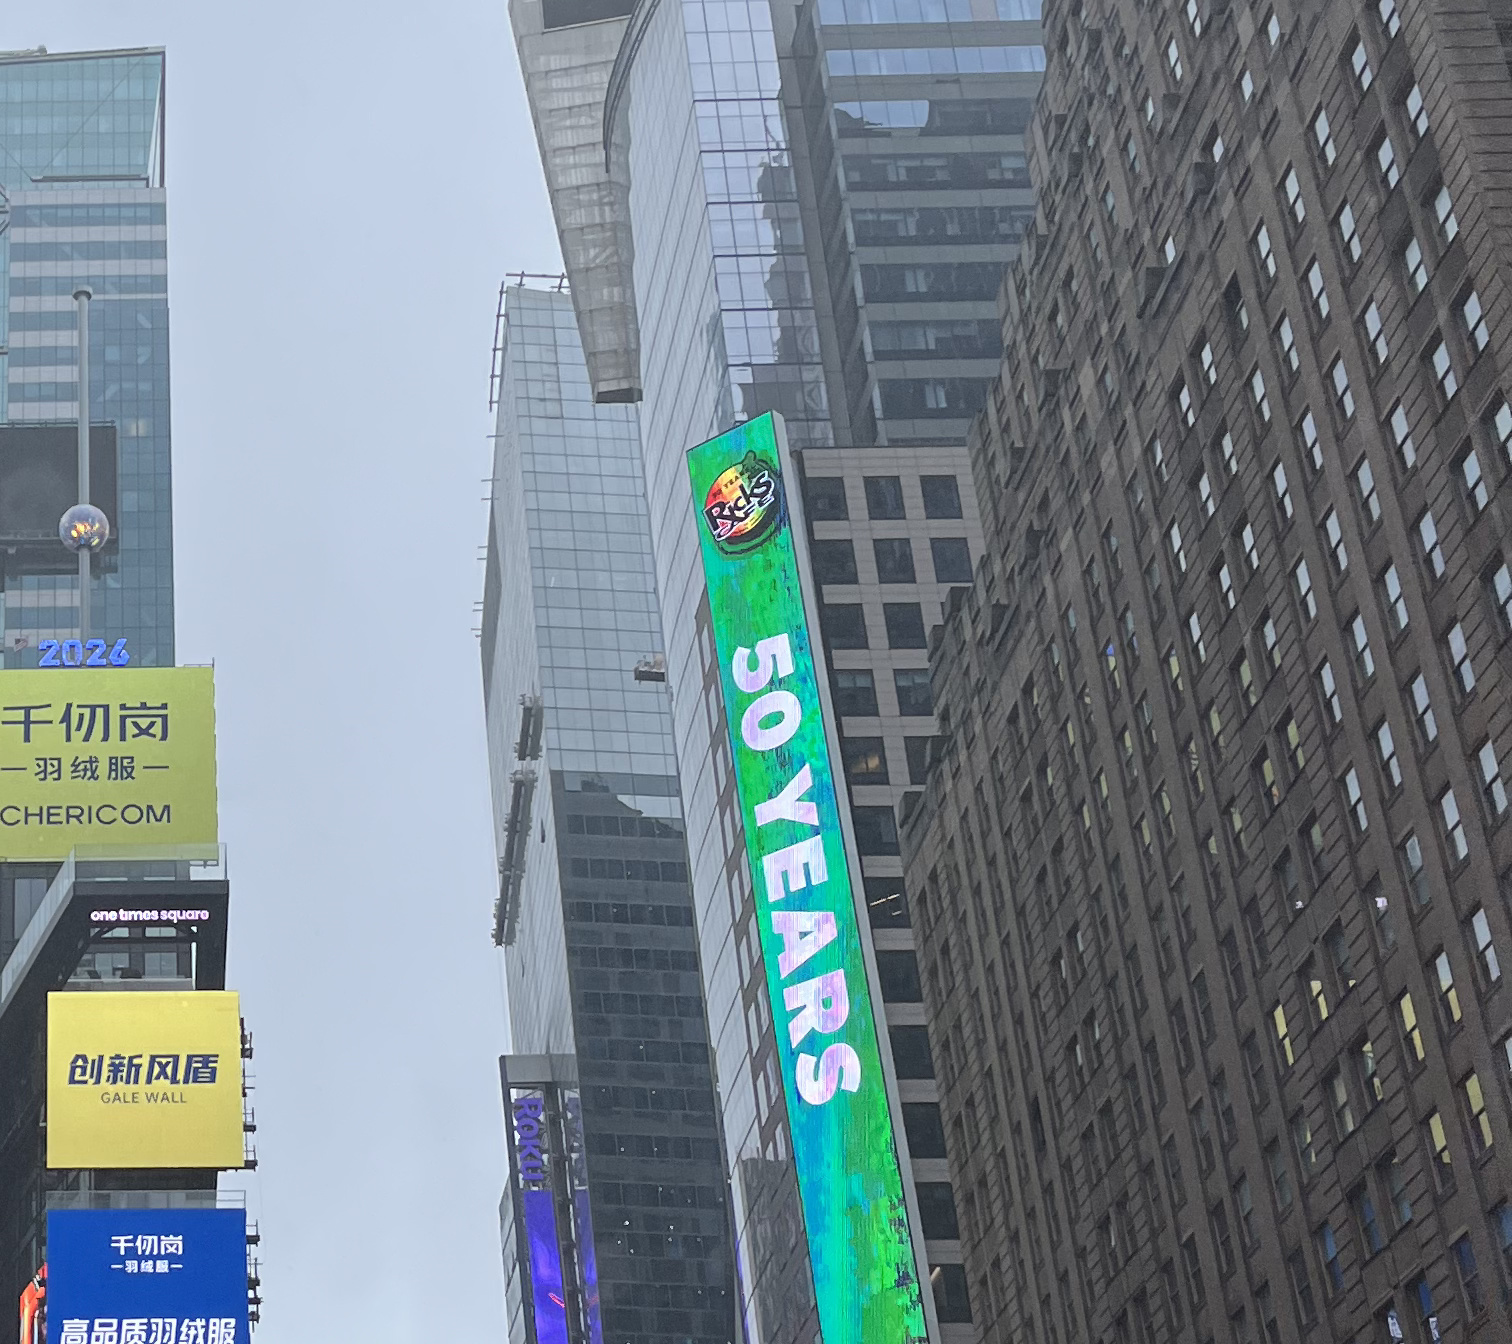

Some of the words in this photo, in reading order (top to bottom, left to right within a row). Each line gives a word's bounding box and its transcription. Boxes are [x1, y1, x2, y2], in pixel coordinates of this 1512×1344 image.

[37, 638, 130, 667] 2026
[731, 642, 803, 753] 50
[1, 701, 169, 743] 千仞岗
[34, 755, 136, 782] 羽绒服
[0, 803, 172, 827] CHERICOM
[90, 910, 117, 921] one
[118, 908, 159, 921] times
[160, 909, 209, 923] square
[755, 777, 861, 1107] YEARS
[68, 1053, 219, 1086] 创新风盾
[100, 1090, 140, 1105] GALE
[145, 1090, 187, 1105] WALL
[110, 1234, 183, 1256] 千仞岗
